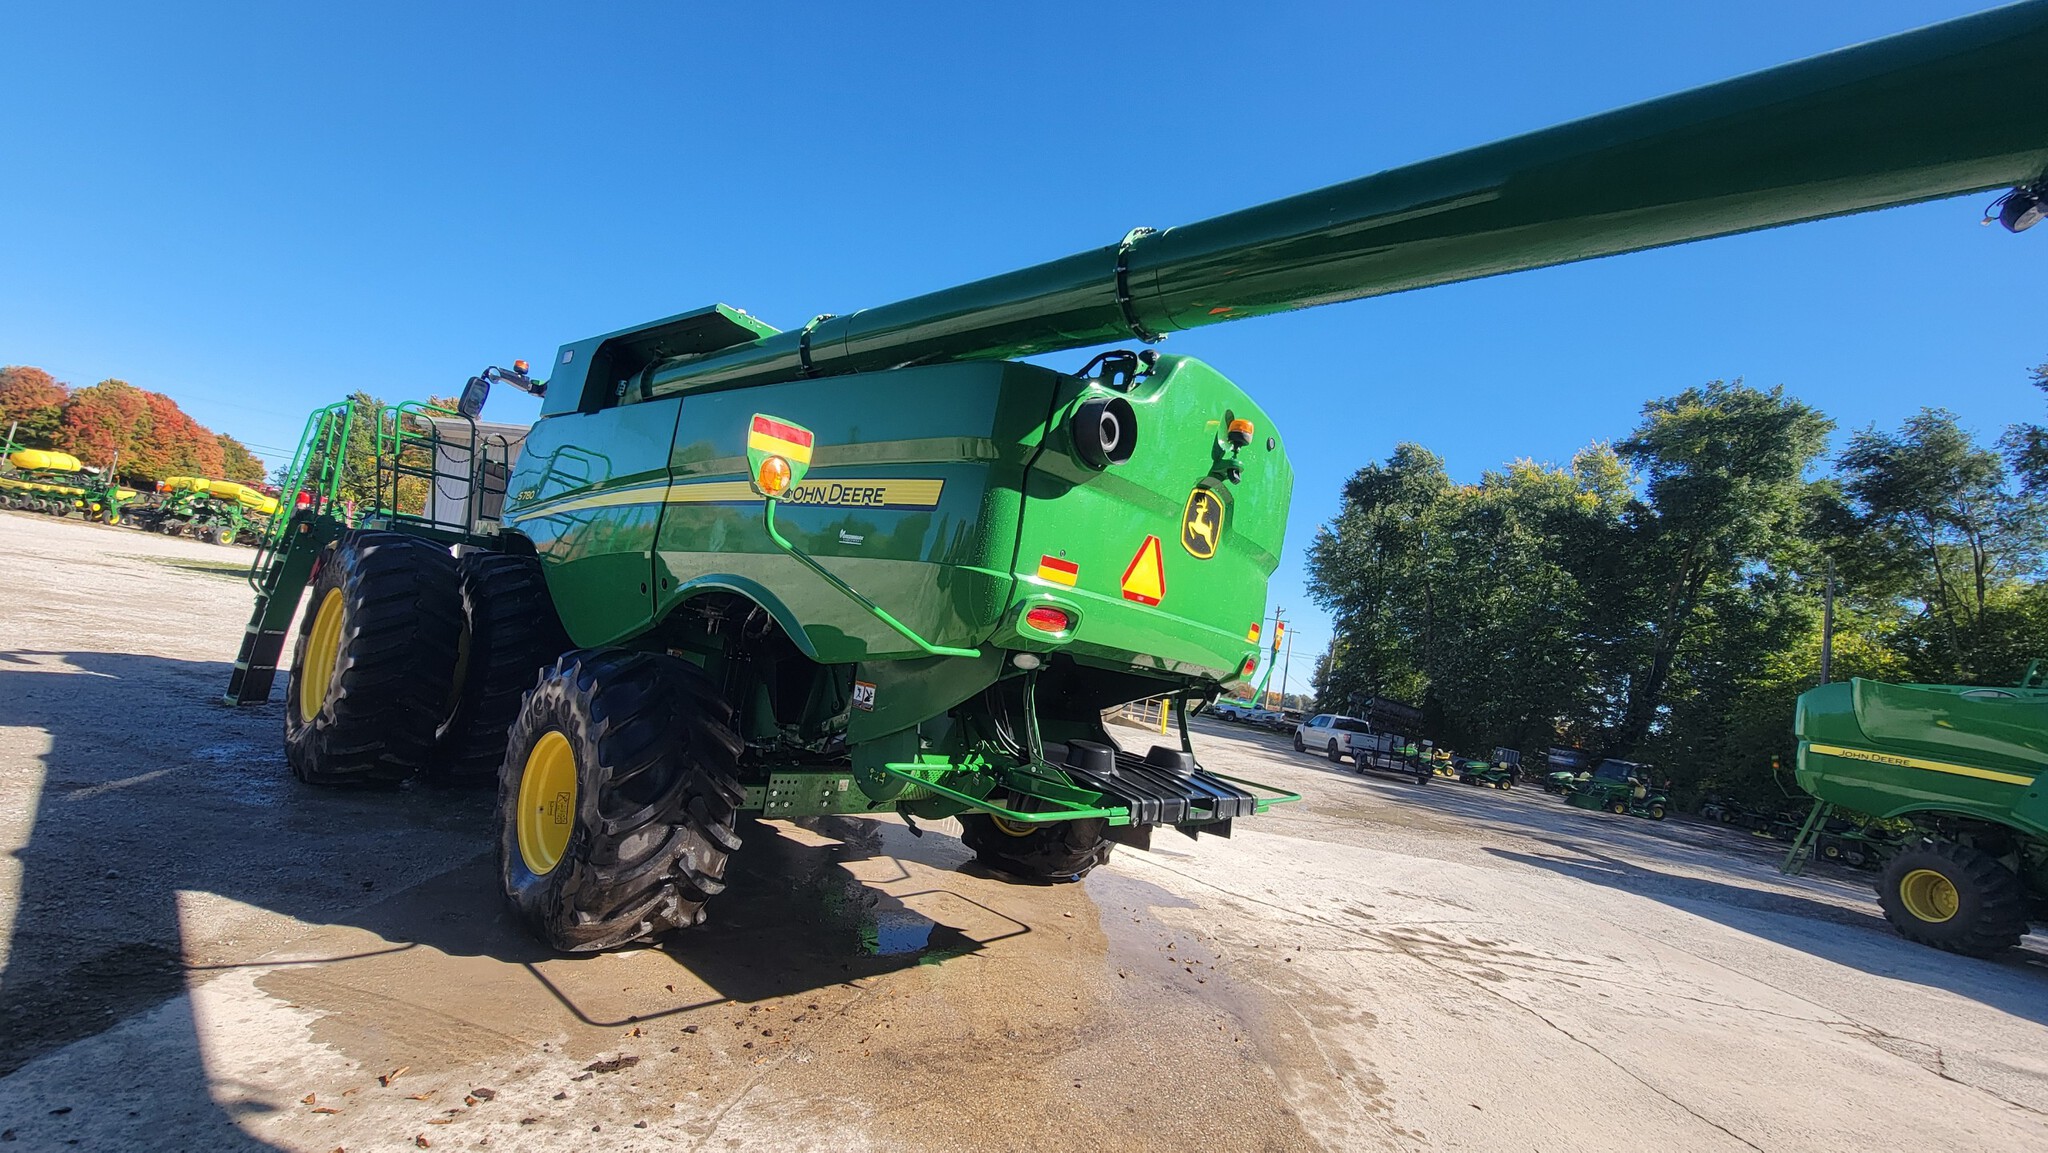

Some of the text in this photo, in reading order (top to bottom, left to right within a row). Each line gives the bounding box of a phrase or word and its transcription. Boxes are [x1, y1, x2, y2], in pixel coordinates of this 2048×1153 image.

[517, 490, 536, 500] S780
[828, 483, 887, 504] DEERE
[1839, 749, 1912, 767] JOHN DEERE
